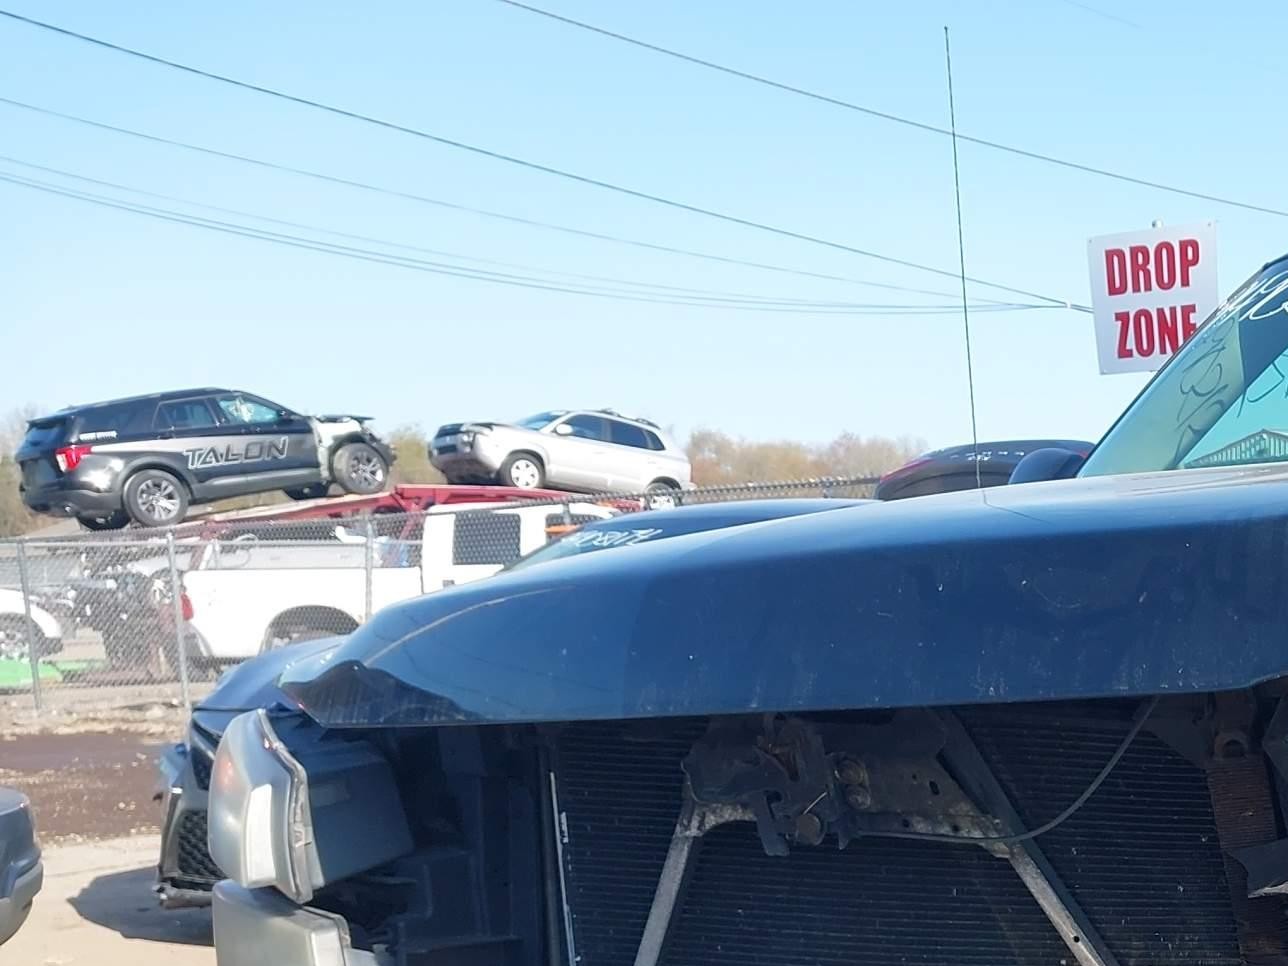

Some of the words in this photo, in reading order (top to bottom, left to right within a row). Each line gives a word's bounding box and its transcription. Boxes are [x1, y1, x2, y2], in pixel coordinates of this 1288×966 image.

[1104, 238, 1200, 297] DROP
[1114, 303, 1198, 359] ZONE
[183, 435, 289, 470] TALON
